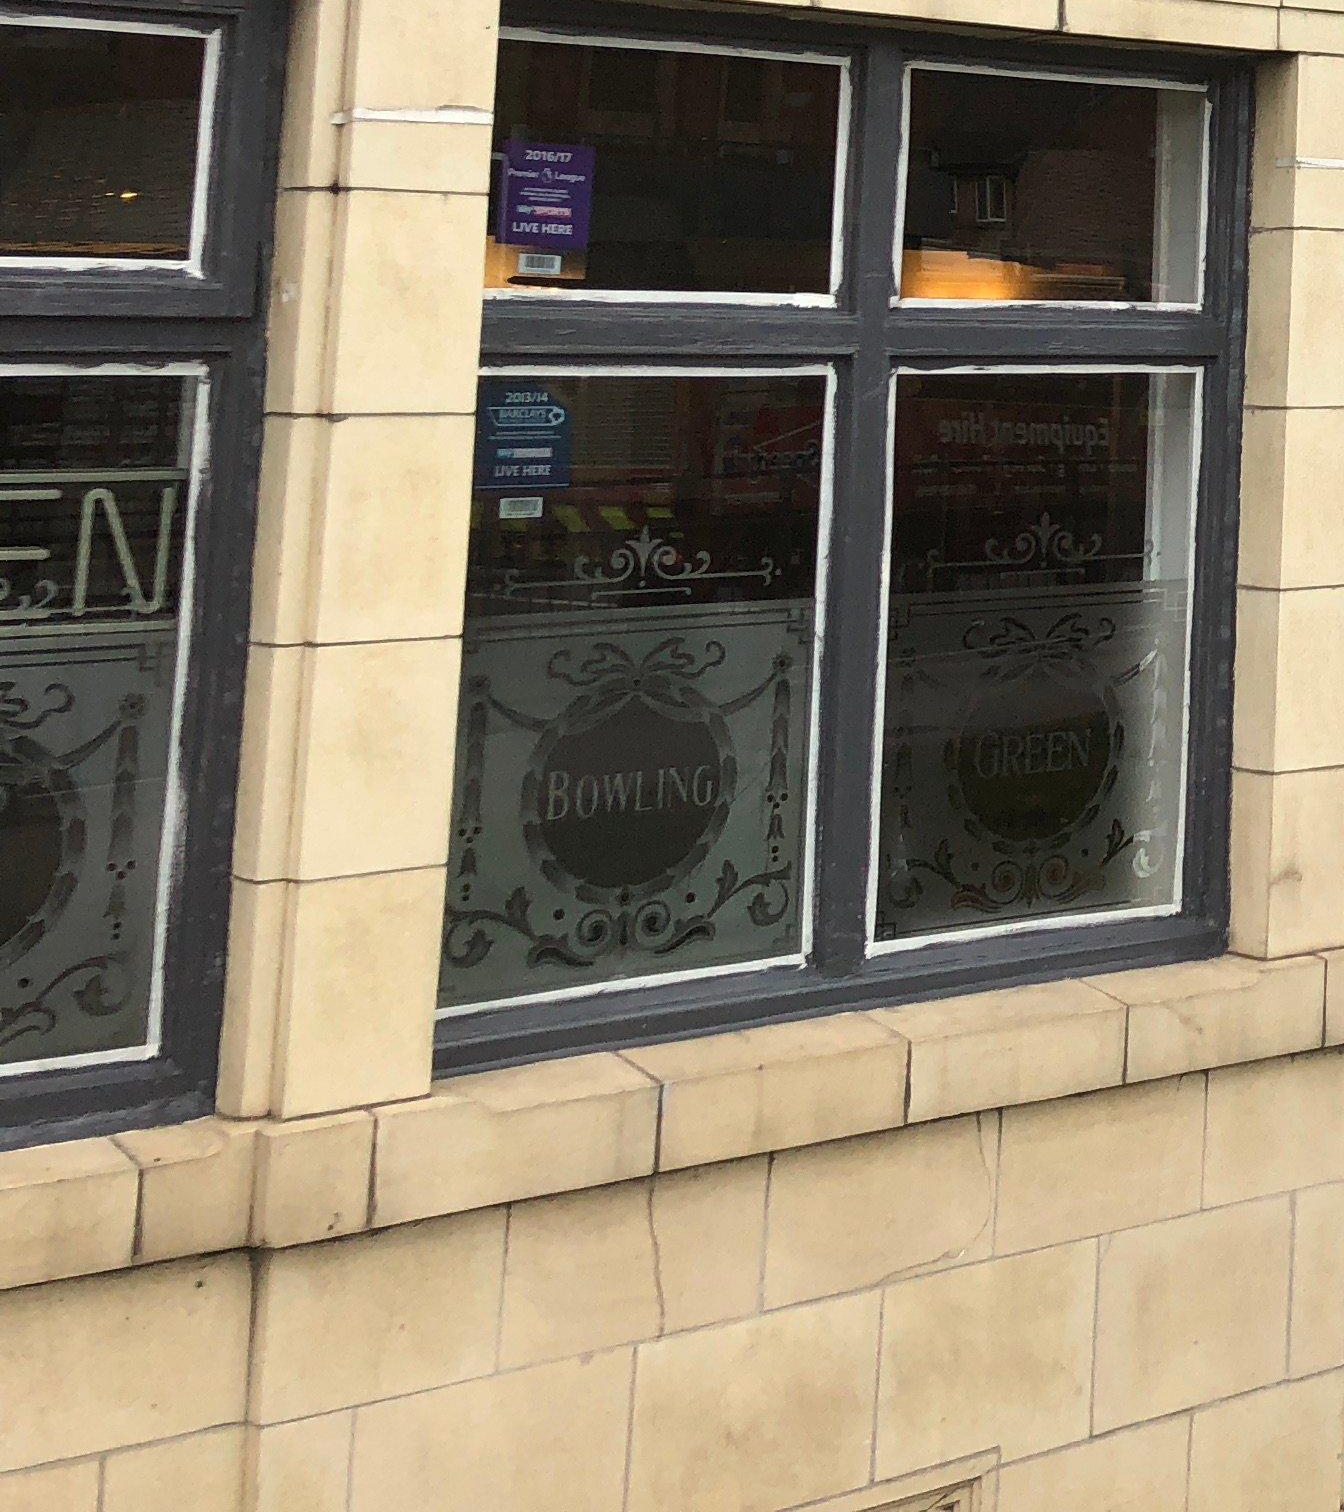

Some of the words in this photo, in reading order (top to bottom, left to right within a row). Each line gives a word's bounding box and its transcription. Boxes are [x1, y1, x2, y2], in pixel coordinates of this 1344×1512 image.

[512, 222, 539, 234] LIVE
[541, 223, 573, 236] HERE
[494, 465, 521, 477] LIVE
[523, 464, 551, 477] HERE
[974, 728, 1094, 779] GREEN
[547, 765, 713, 820] BOWLING
